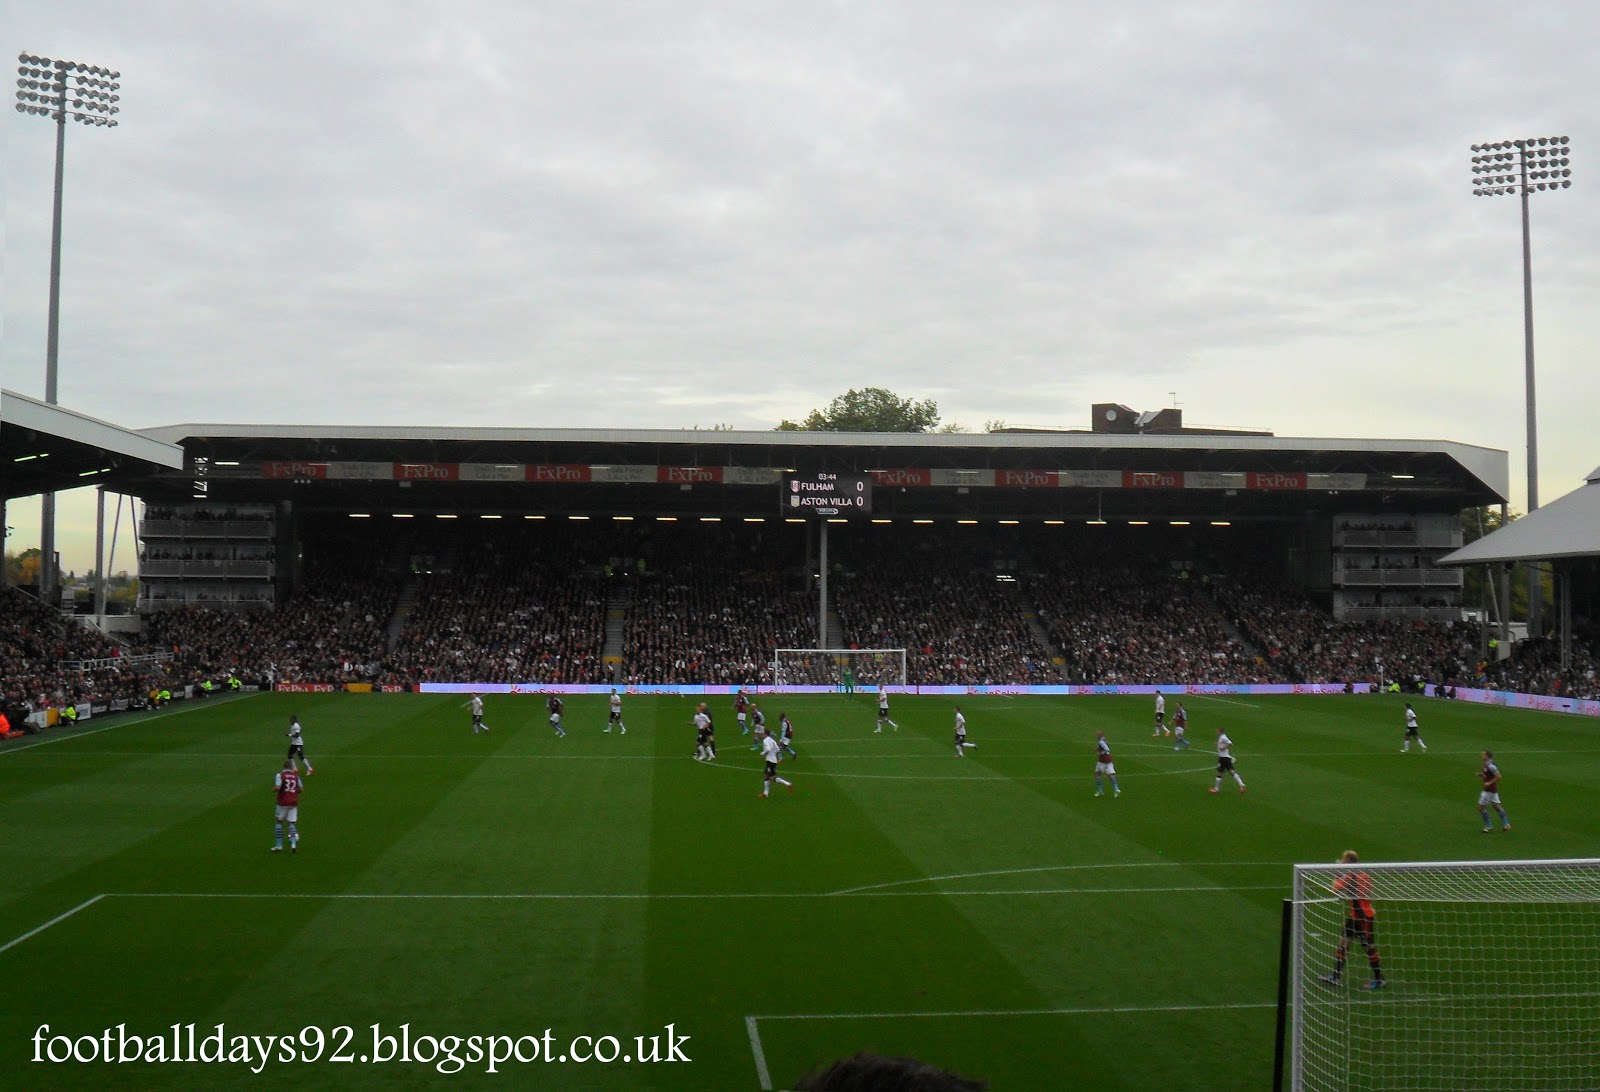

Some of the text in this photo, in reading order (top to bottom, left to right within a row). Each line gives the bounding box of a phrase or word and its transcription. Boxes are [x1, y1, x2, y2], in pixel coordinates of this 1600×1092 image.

[404, 465, 448, 478] FxPro
[536, 466, 581, 480] FxPro
[669, 467, 713, 481] FxPro
[877, 470, 921, 484] FxPro
[1006, 471, 1048, 485] FxPro
[1132, 472, 1175, 486] FxPro
[1256, 474, 1298, 487] FxPro
[801, 481, 864, 492] FULHAM 0
[801, 496, 864, 507] ASTON VILLA 0
[284, 779, 297, 793] 32
